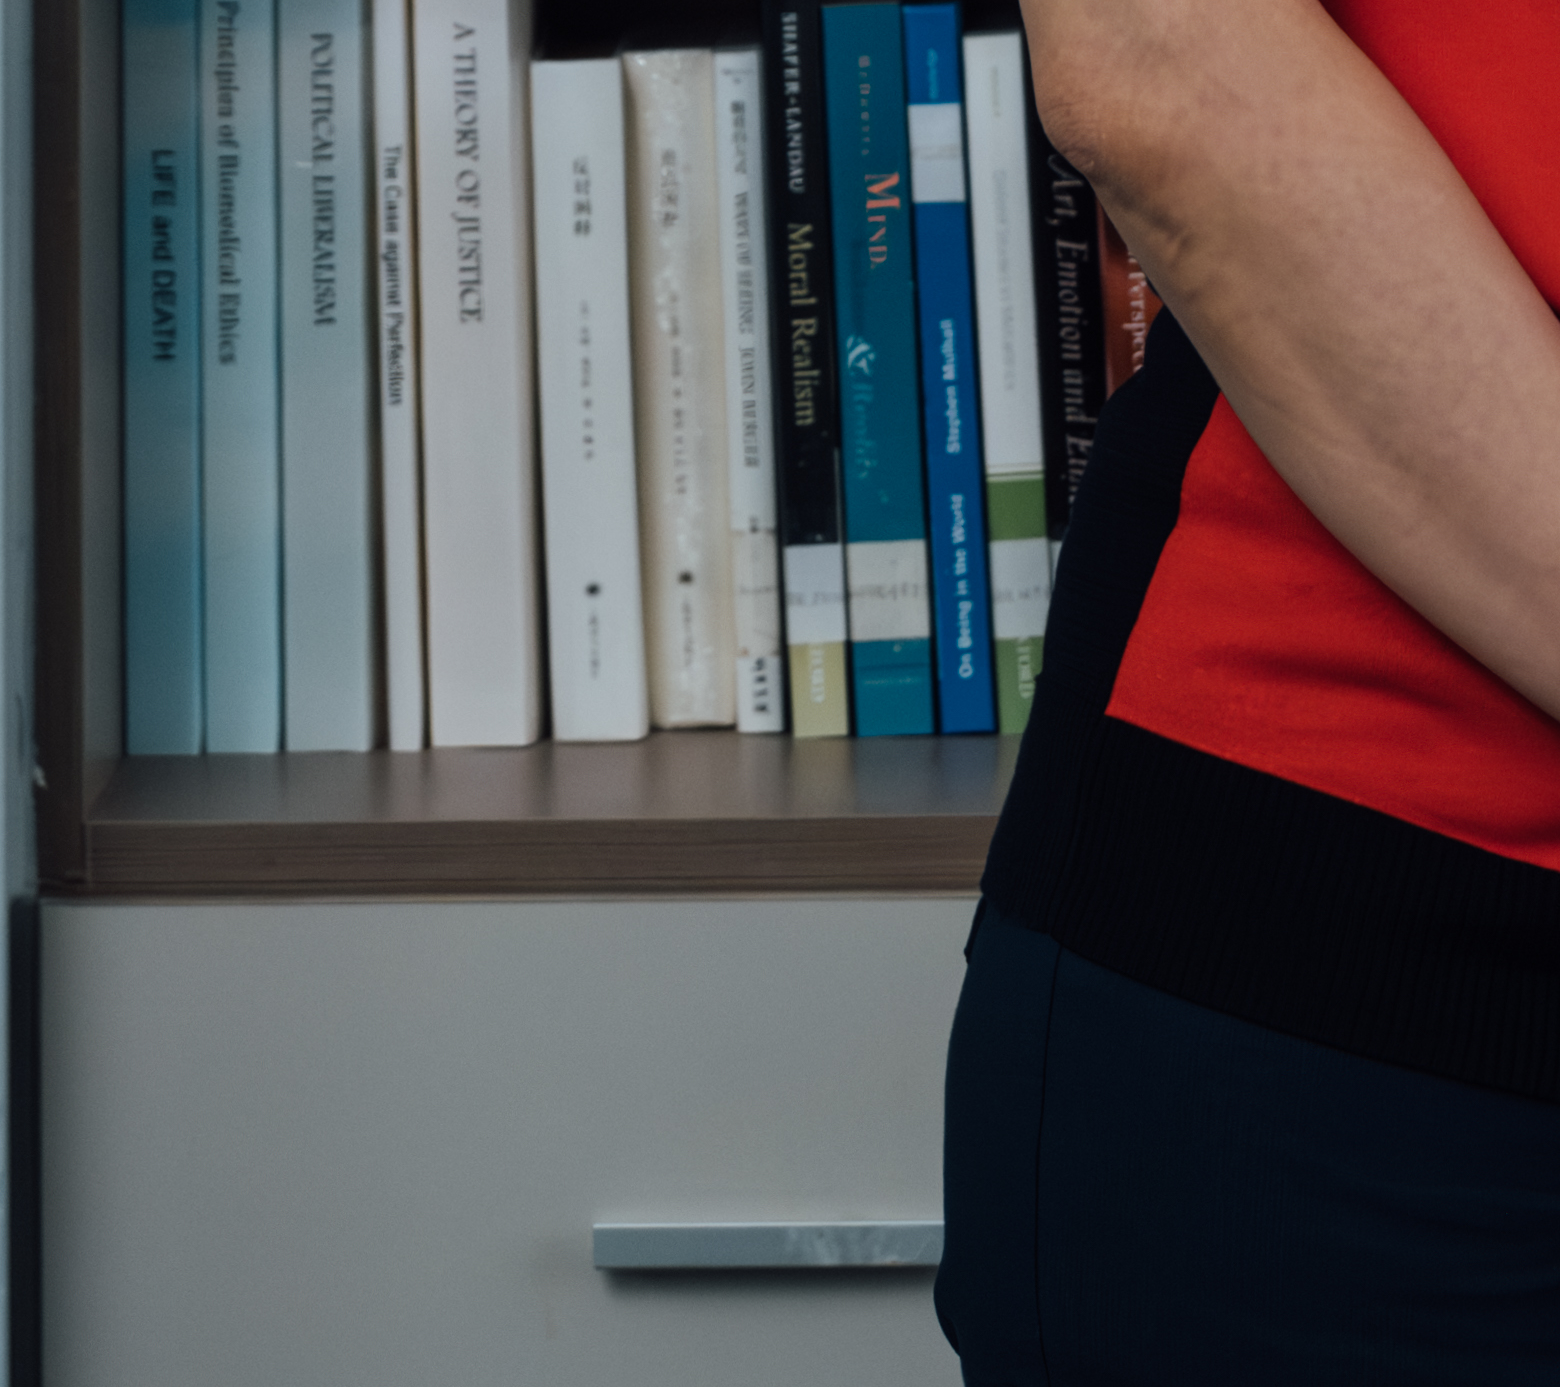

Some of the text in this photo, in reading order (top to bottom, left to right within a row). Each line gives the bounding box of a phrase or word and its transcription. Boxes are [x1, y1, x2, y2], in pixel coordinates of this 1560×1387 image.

[213, 0, 244, 365] Principles of Biomedical Ethics
[309, 32, 338, 327] POLITICAL LIBERALISM
[450, 22, 485, 323] A THEORY OF JUSTICE
[781, 10, 807, 193] SHAFER-LANDAU
[151, 149, 178, 361] LIFE and DEATH
[379, 144, 407, 406] The Case against Perfection
[786, 222, 820, 426] Moral Realism
[1044, 155, 1098, 423] Art, Emotion and
[939, 319, 976, 679] On Being in the World Stephen Mulhall
